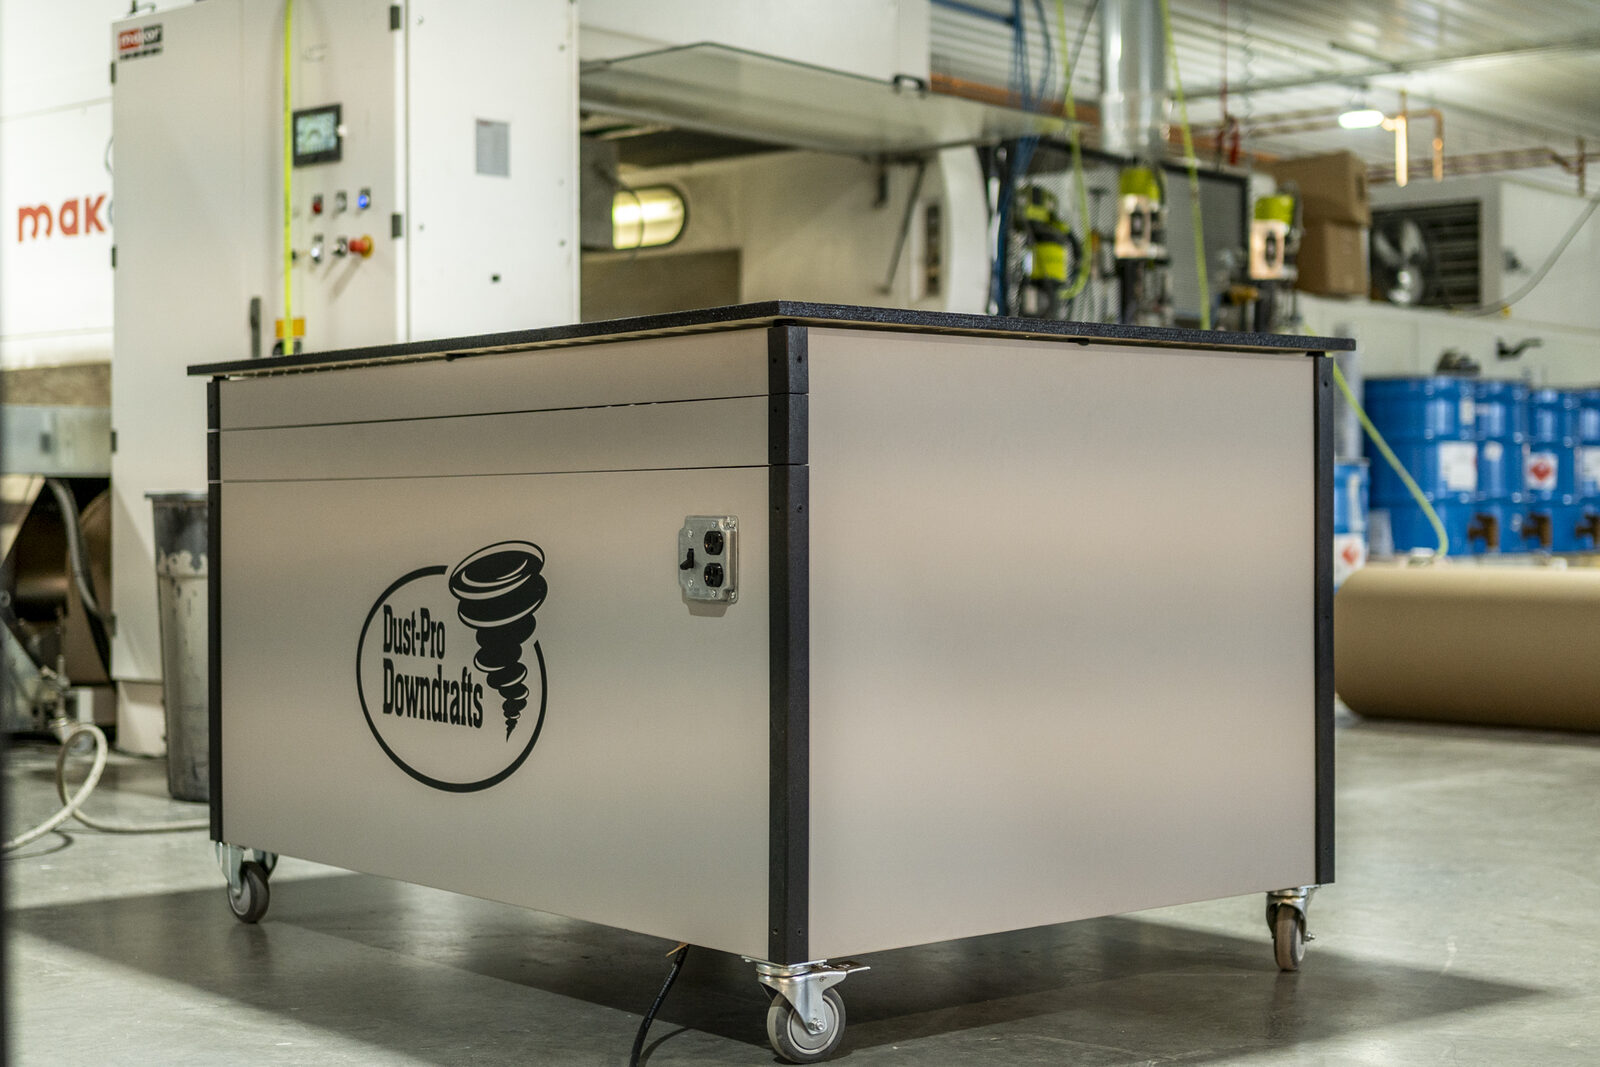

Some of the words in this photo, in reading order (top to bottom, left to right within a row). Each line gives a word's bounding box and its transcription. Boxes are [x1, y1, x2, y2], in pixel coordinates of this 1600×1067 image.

[18, 194, 112, 242] mak
[383, 604, 445, 660] Dust-Pro
[383, 658, 483, 729] Downdrafts
